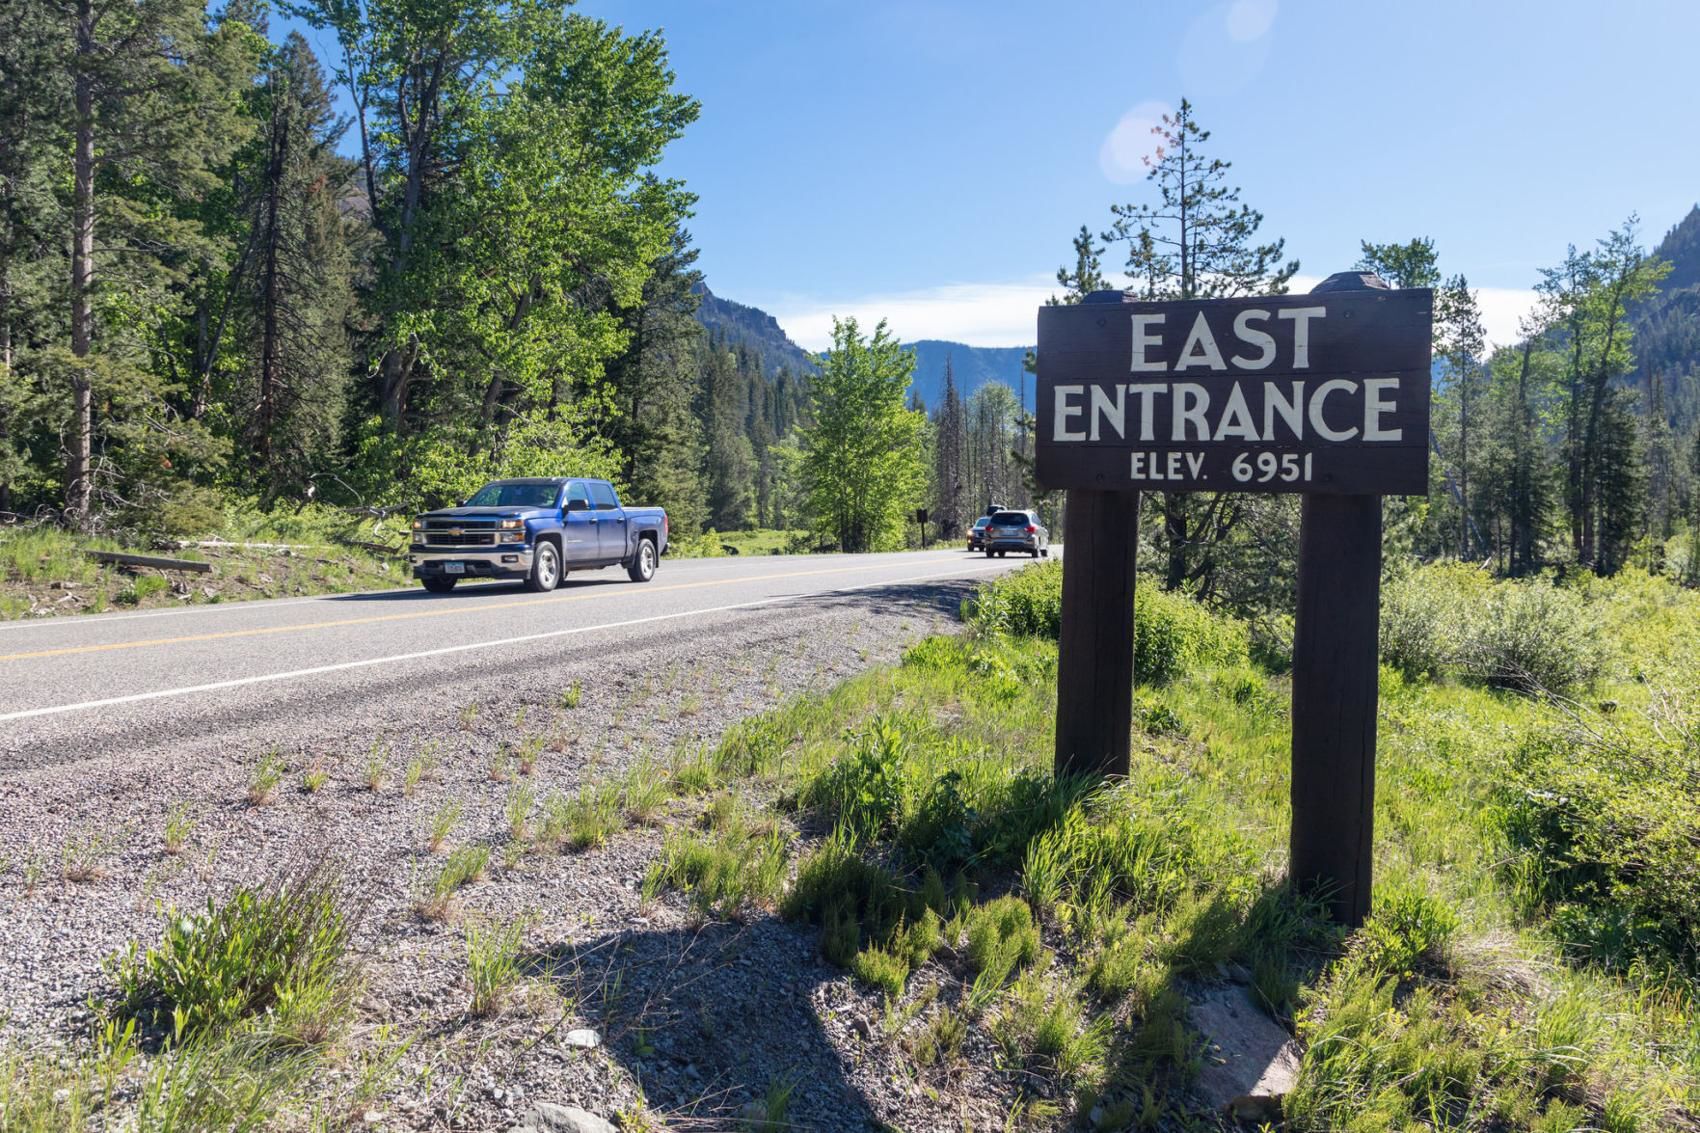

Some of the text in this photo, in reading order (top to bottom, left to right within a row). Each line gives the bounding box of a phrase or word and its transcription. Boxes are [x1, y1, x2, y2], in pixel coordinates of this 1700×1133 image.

[1131, 306, 1326, 371] EAST
[1053, 378, 1403, 442] ENTRANCE
[1131, 451, 1312, 482] ELEV. 6951
